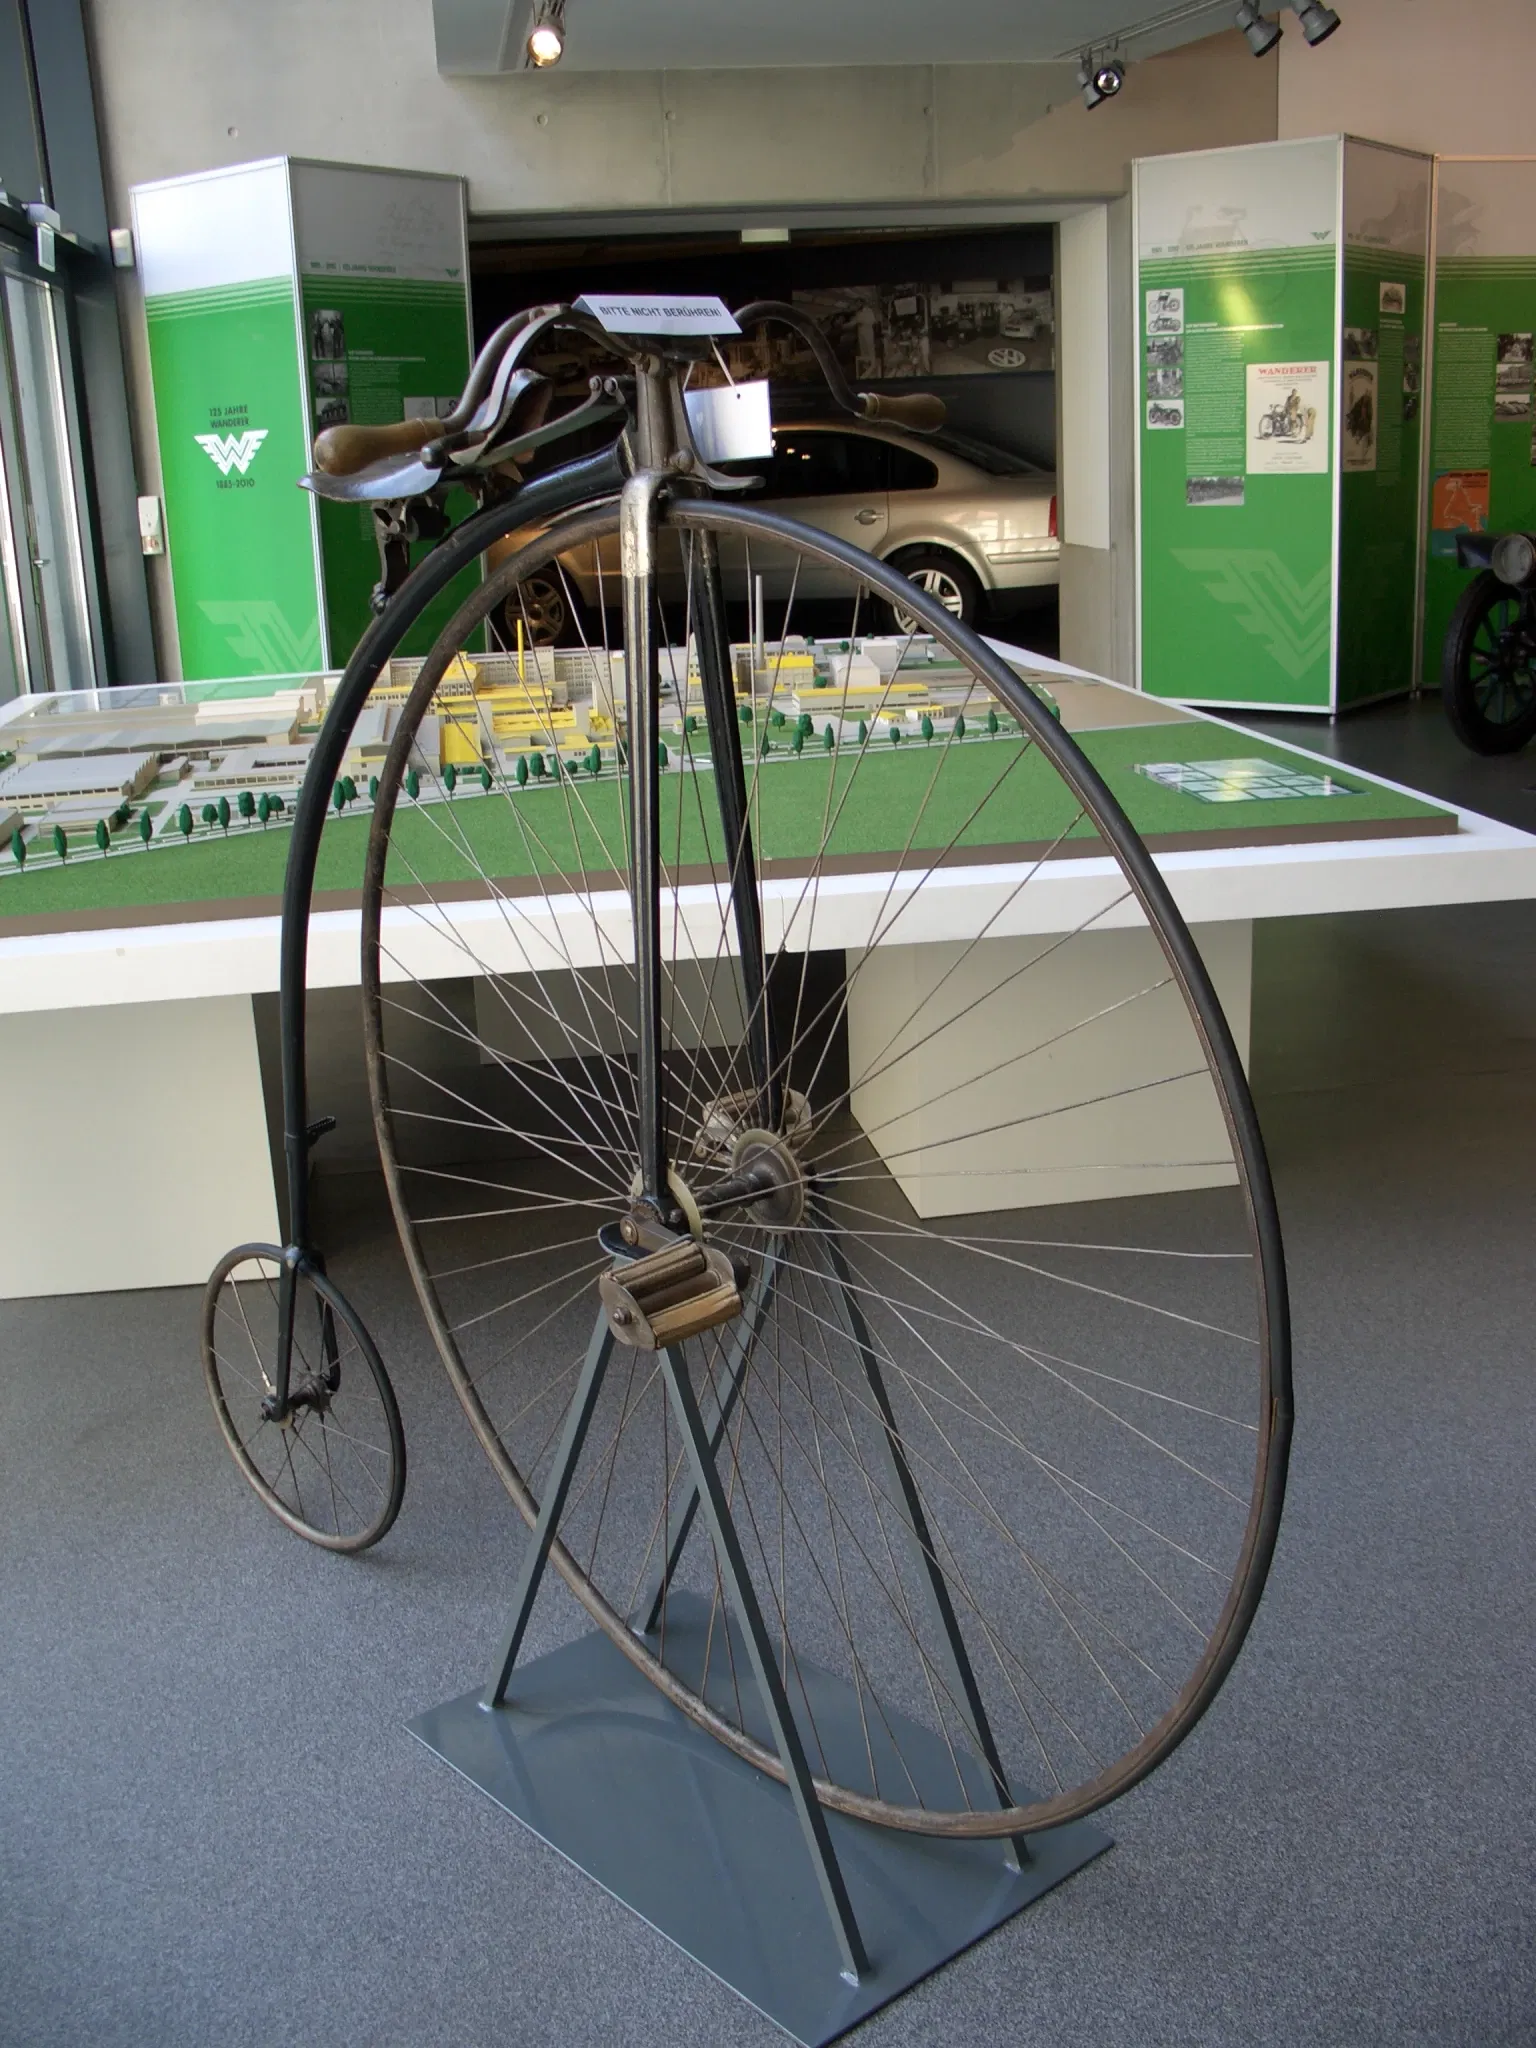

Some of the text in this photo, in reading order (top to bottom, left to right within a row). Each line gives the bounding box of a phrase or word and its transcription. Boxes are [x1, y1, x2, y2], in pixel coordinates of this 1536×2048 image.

[599, 305, 722, 317] BITTE NICHT BERÜHREN!
[1258, 365, 1318, 375] WANDERER
[209, 404, 248, 417] 125 JAHRE
[210, 416, 250, 429] WANDERER
